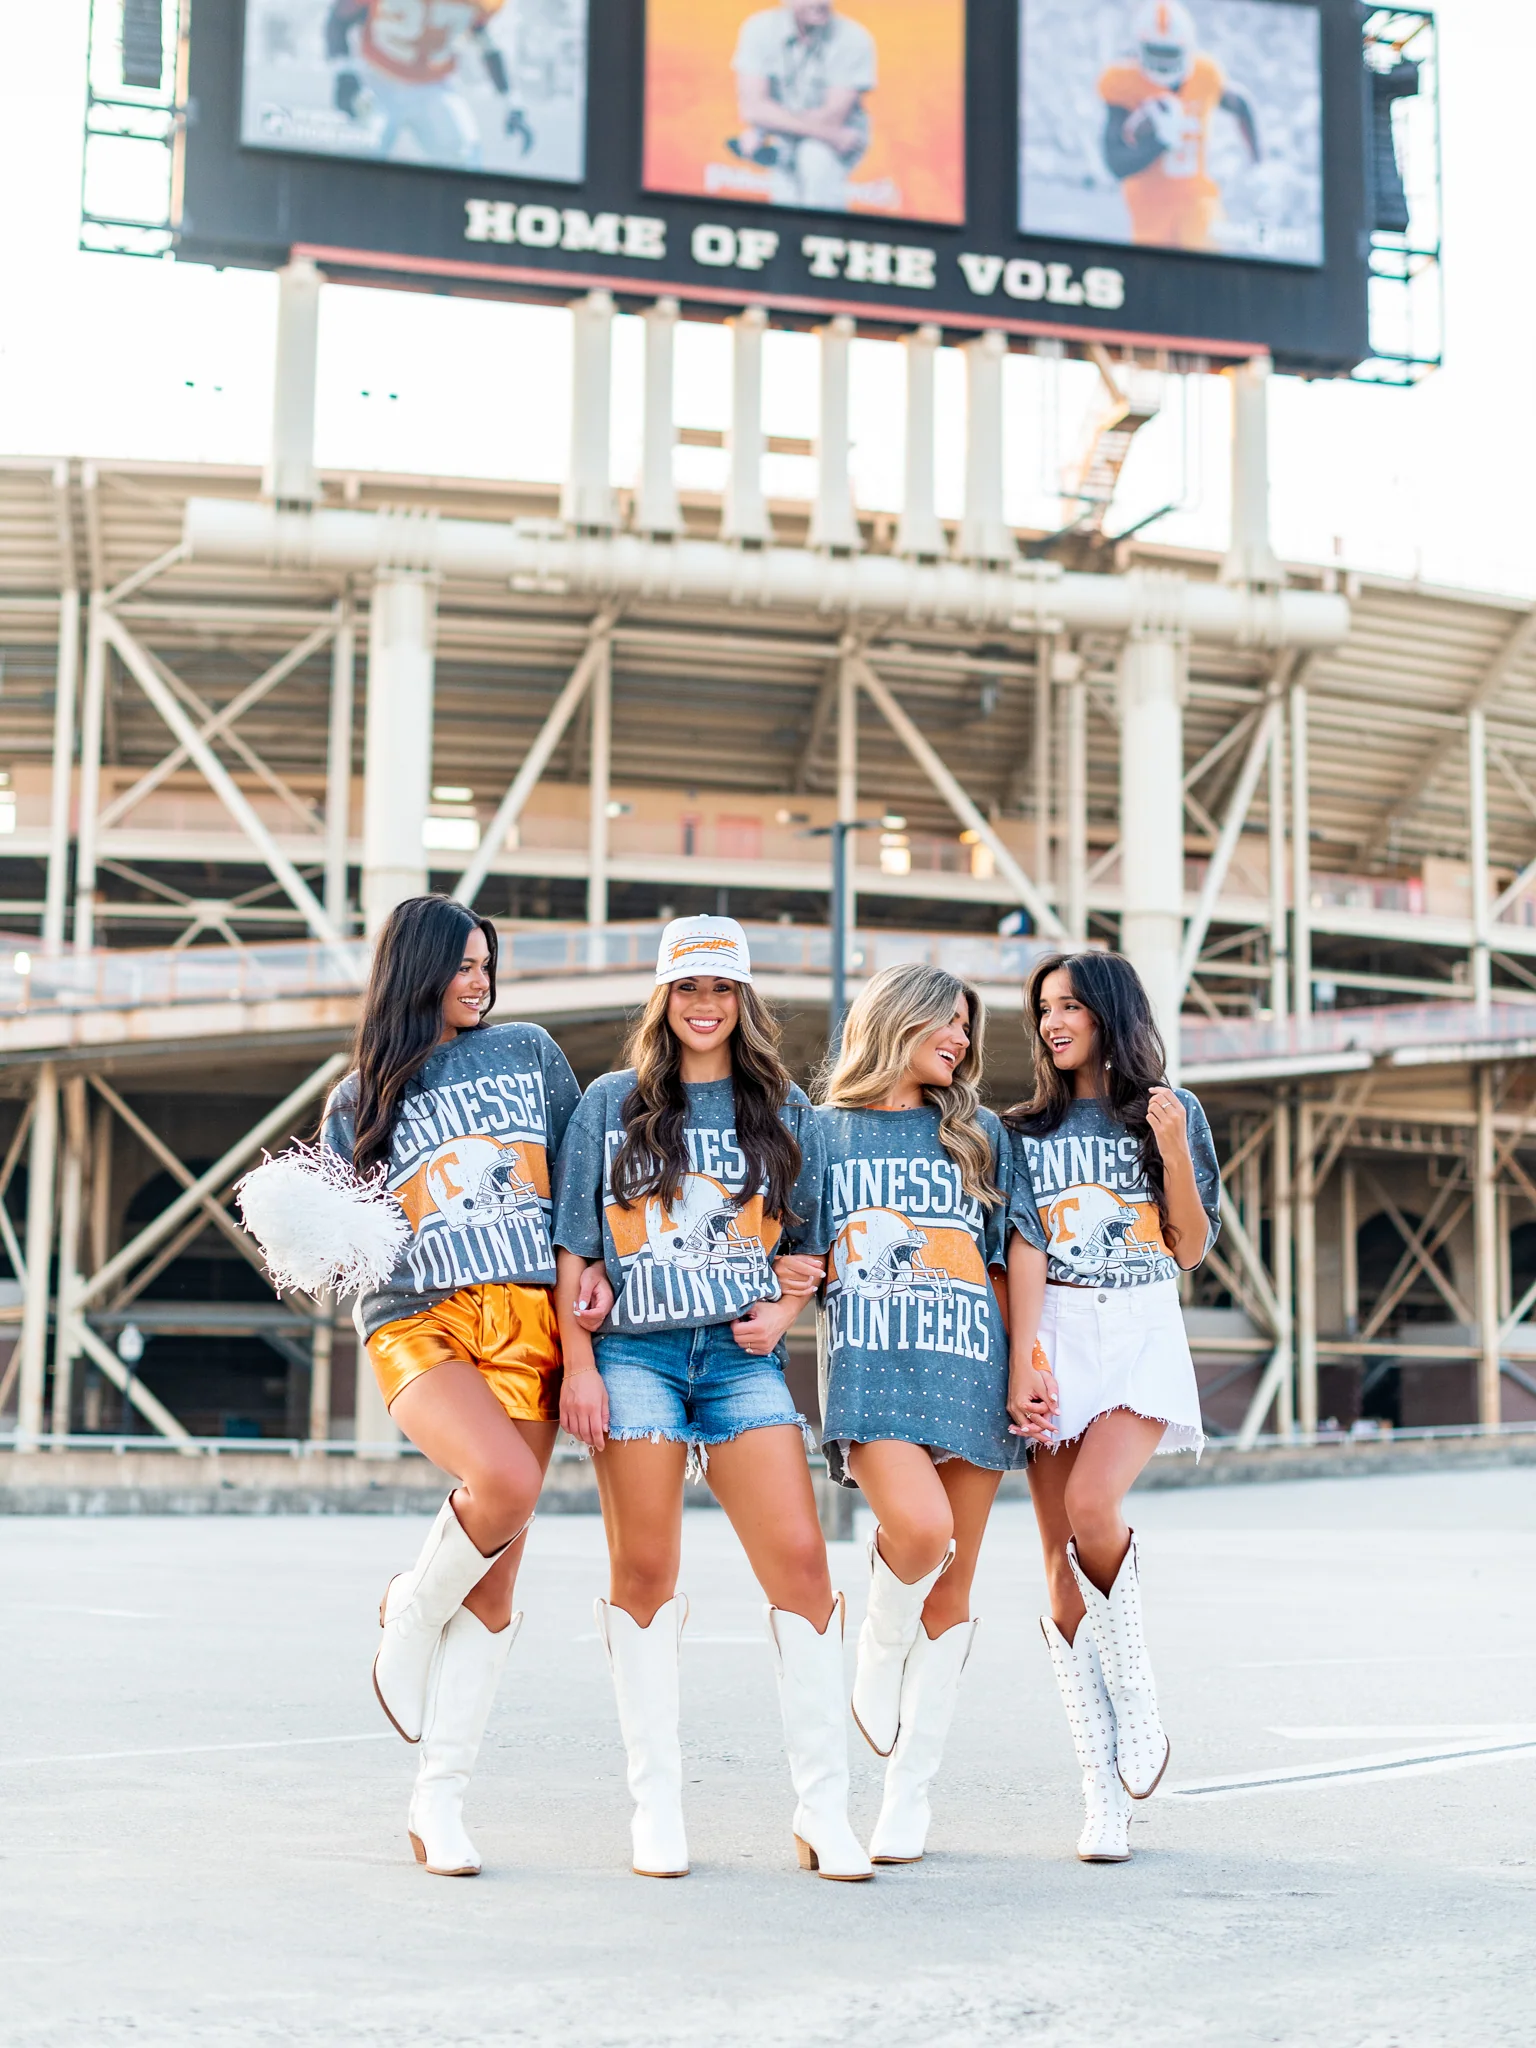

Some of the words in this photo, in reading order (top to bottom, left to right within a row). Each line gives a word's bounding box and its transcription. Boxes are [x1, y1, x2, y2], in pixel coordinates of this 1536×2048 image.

[464, 199, 667, 260] HOME
[691, 223, 780, 270] OF
[802, 234, 937, 290] THE
[957, 252, 1125, 310] VOLS
